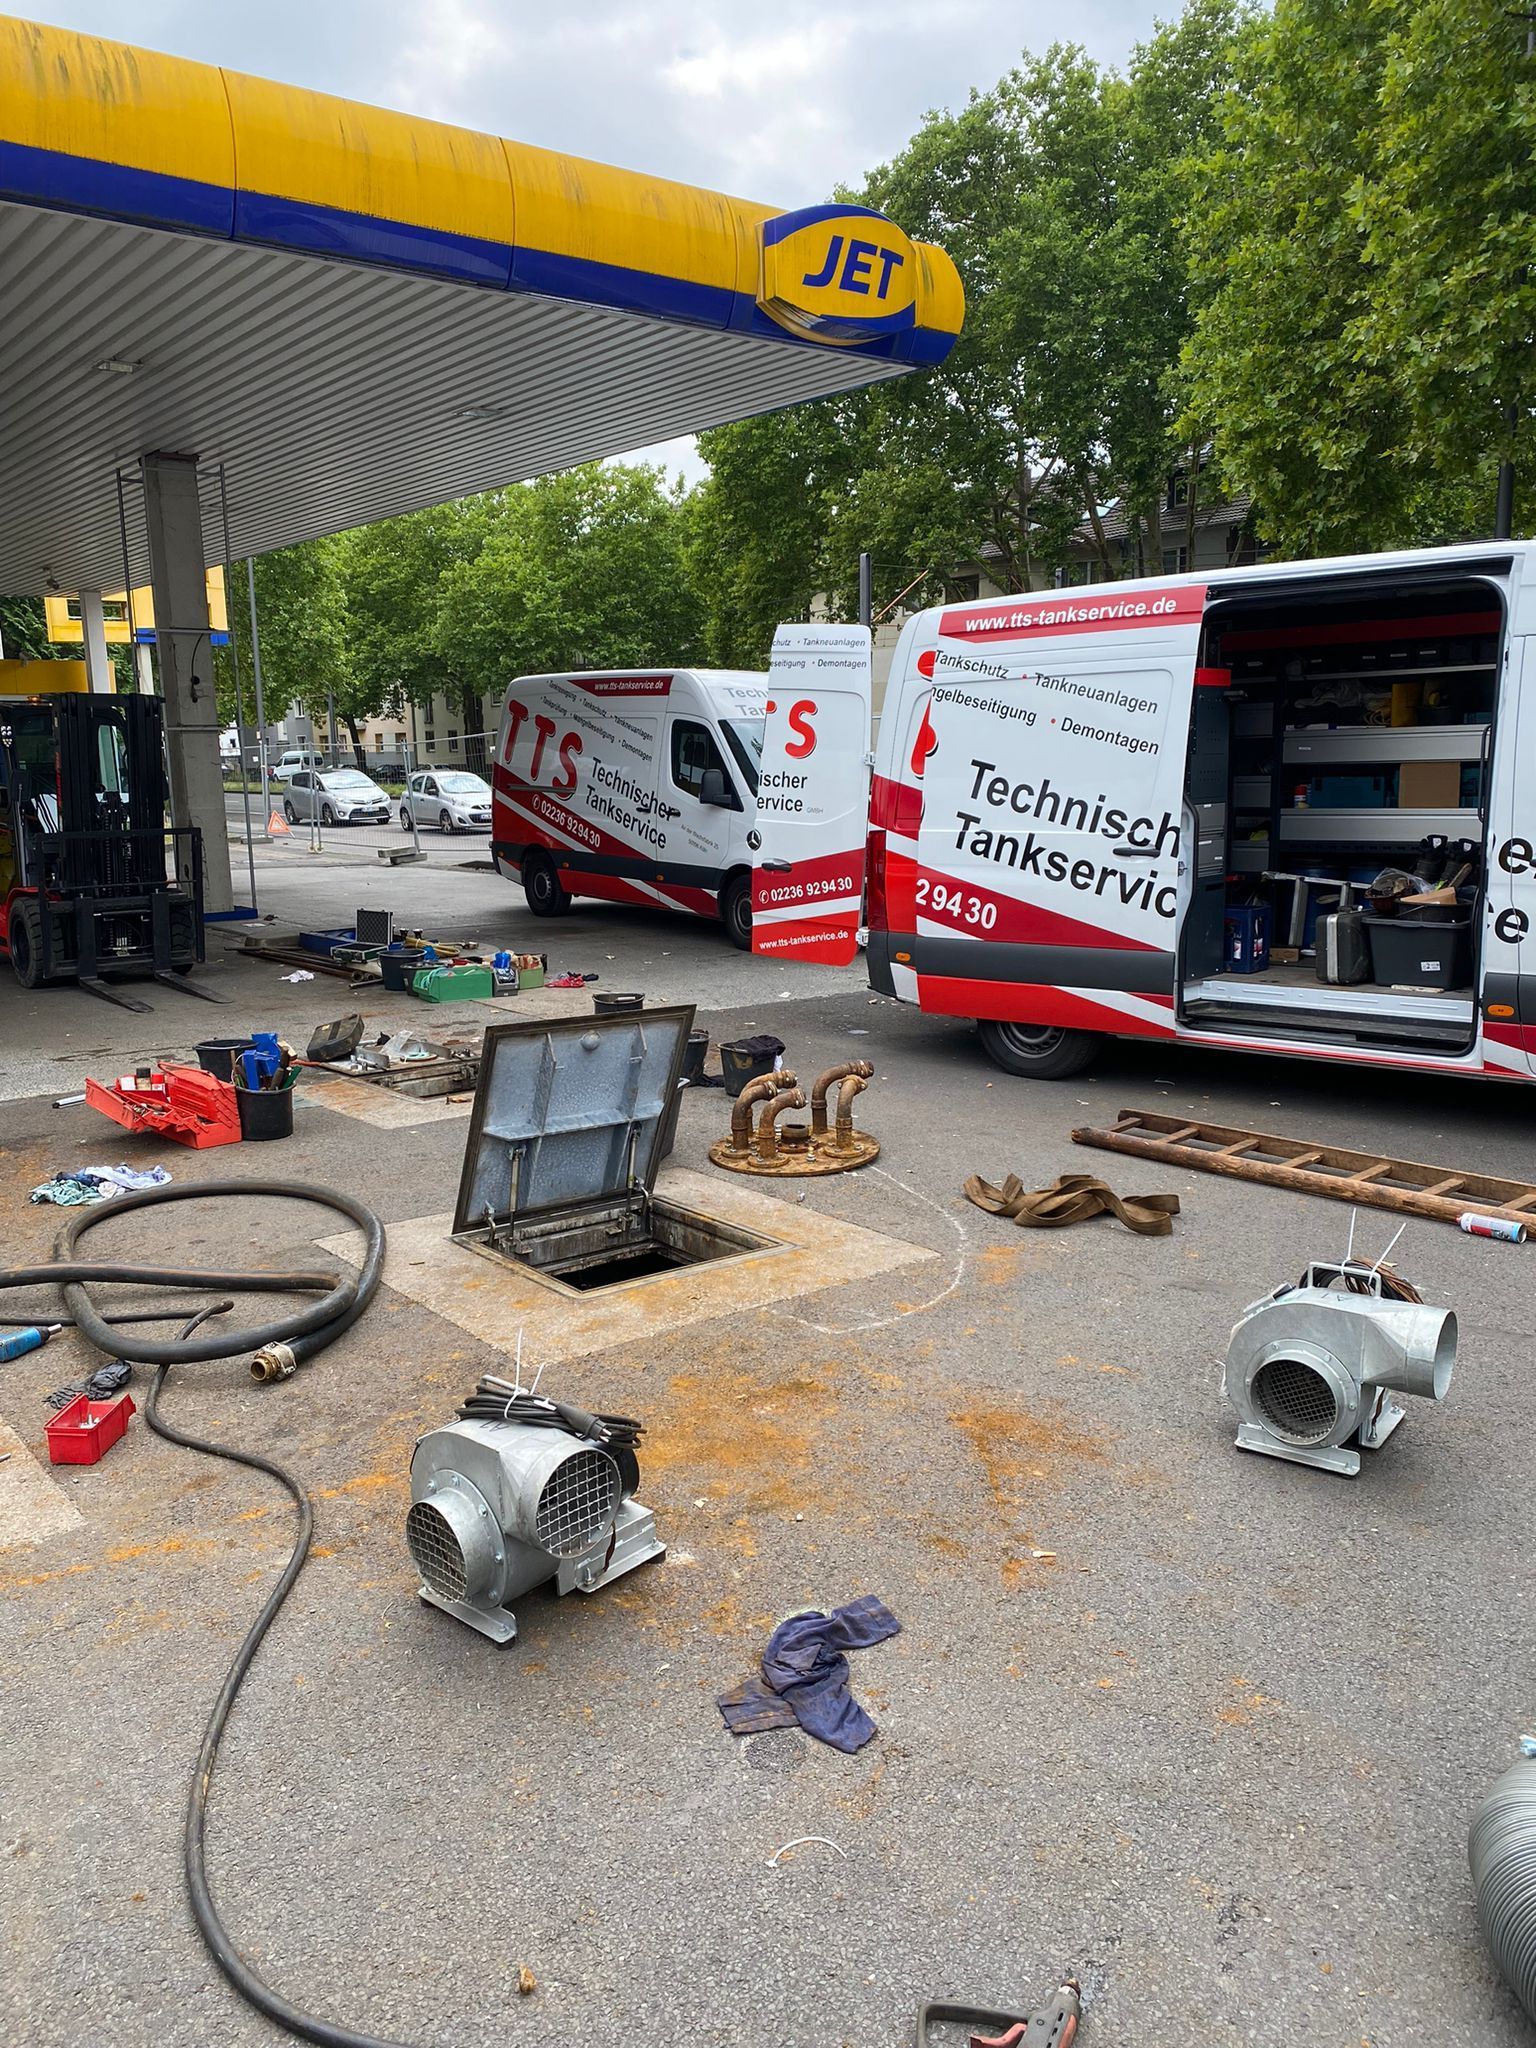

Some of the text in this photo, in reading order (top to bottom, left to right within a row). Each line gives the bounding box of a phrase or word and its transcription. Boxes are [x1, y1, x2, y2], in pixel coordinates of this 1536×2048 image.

[802, 235, 904, 299] JET
[966, 597, 1177, 632] www.tts-tankservice.de
[803, 638, 866, 648] Tankneuanlagen
[817, 659, 867, 669] Demontagen
[934, 649, 1158, 714] Tankschutz Tankneuanlagen
[594, 679, 664, 690] www.tts-tankservice.de
[723, 688, 768, 698] Tech
[505, 699, 584, 800] TTS
[621, 739, 653, 762] Demontagen
[1060, 717, 1159, 755] Demontagen
[592, 756, 678, 821] Technischer
[541, 801, 565, 825] 02236
[585, 784, 667, 849] Tankservice
[969, 758, 1181, 859] Technisch
[954, 811, 1177, 919] Tankservic
[771, 885, 804, 901] 02236
[759, 930, 848, 950] www.tts-tankservice.de
